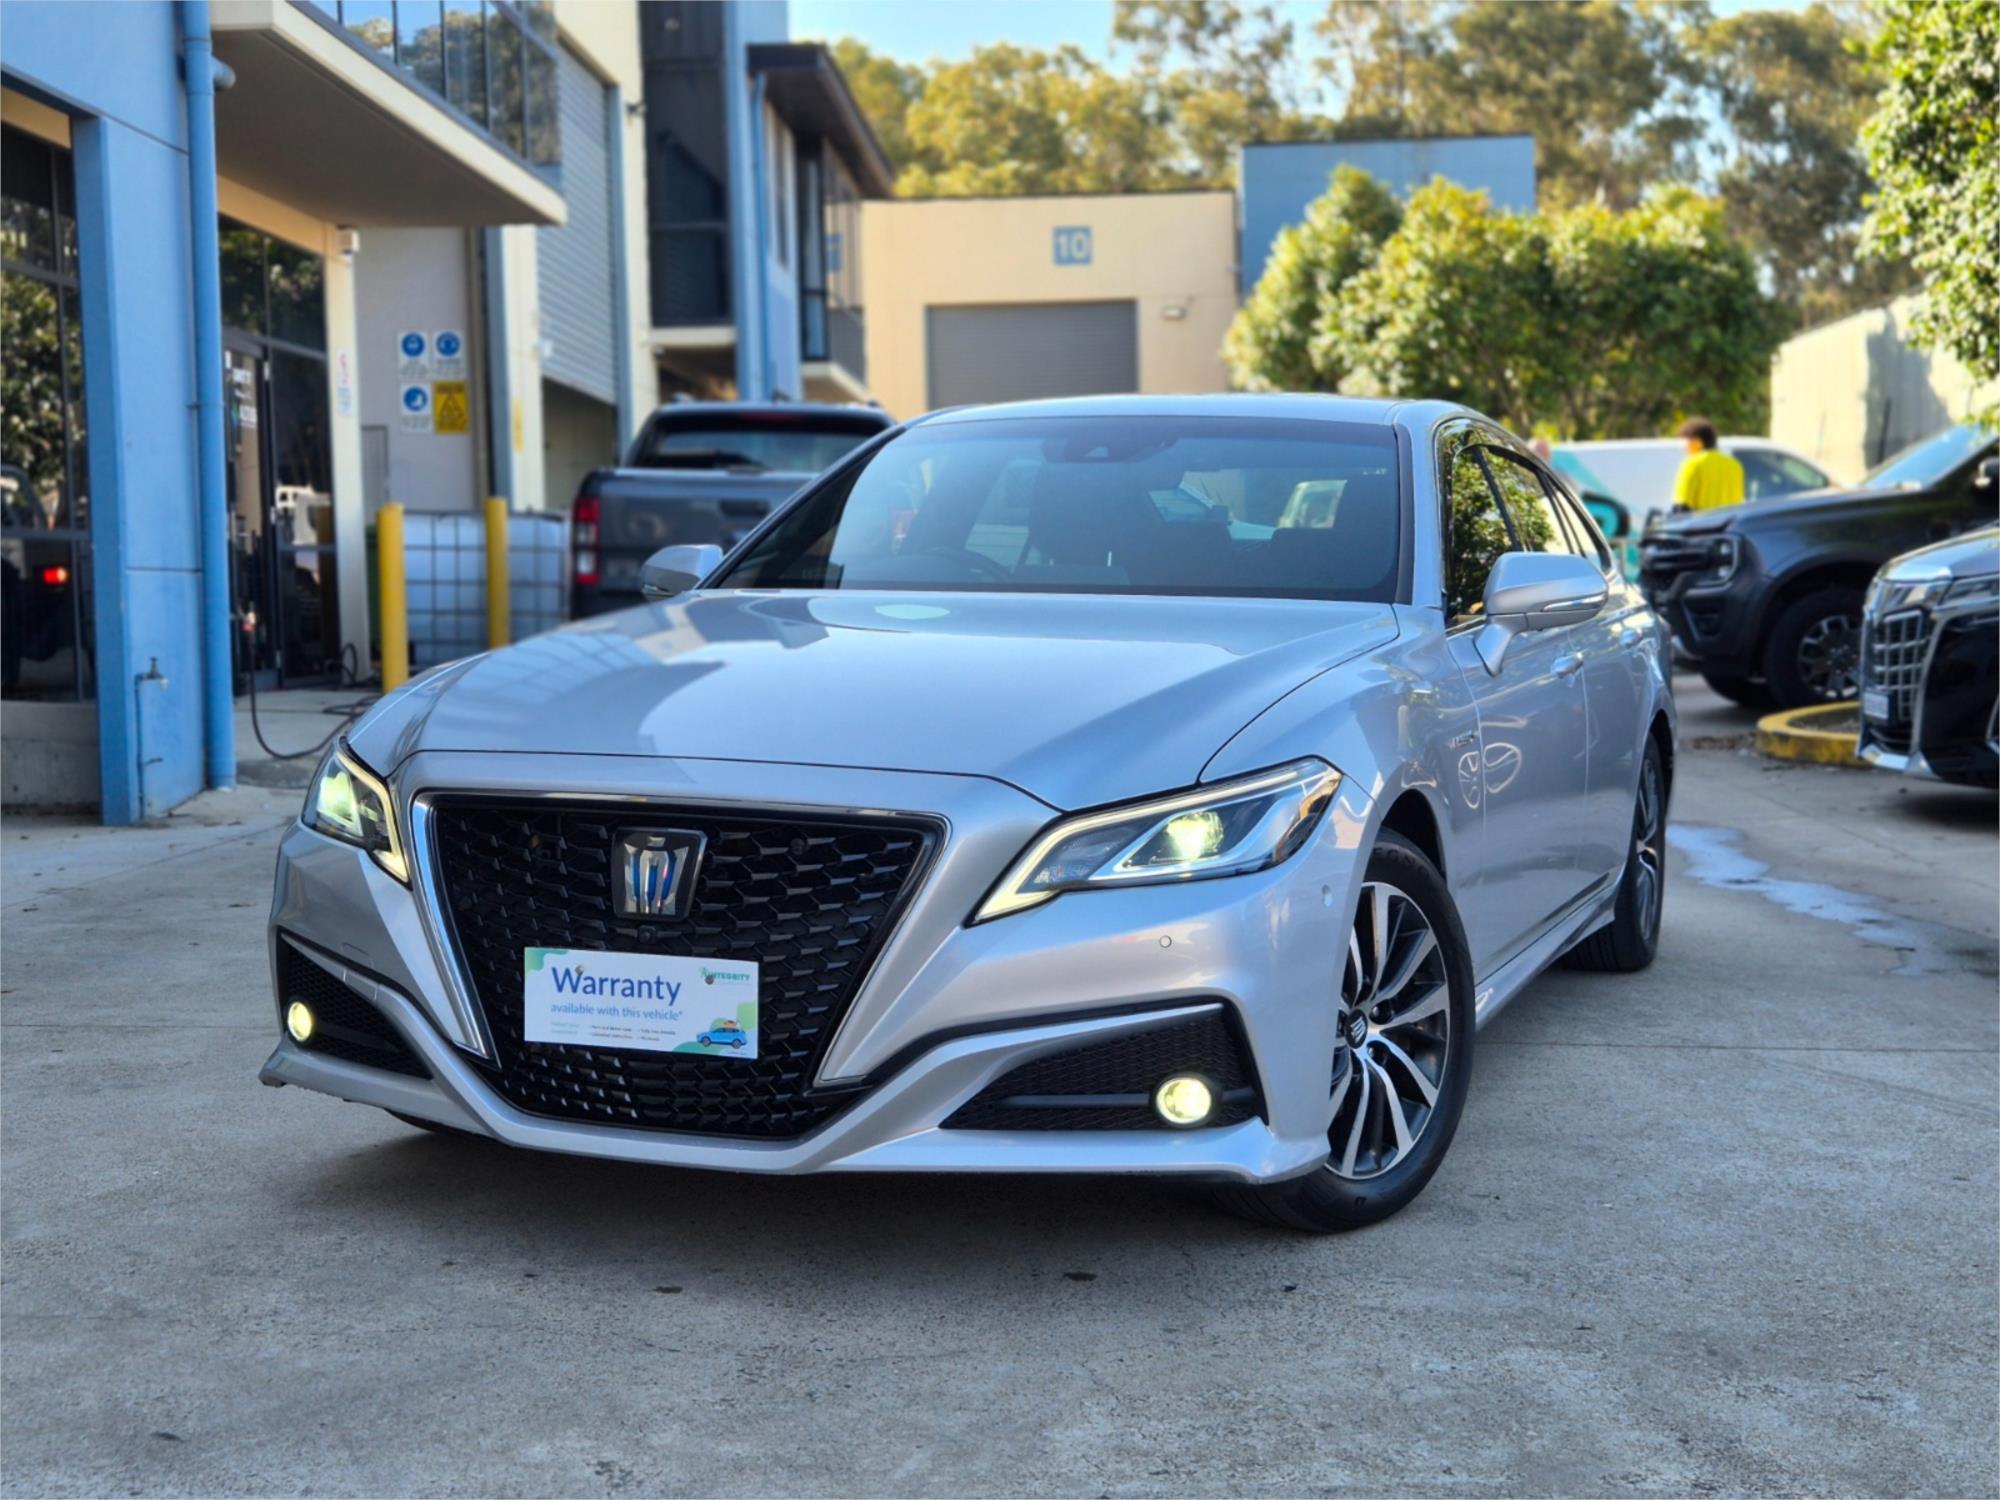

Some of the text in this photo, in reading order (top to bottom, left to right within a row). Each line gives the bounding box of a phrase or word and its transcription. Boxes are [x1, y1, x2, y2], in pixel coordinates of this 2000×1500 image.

[1058, 232, 1091, 259] 10
[551, 967, 682, 1006] Warranty
[551, 1003, 594, 1015] available
[596, 1006, 619, 1017] with
[622, 1007, 640, 1018] this
